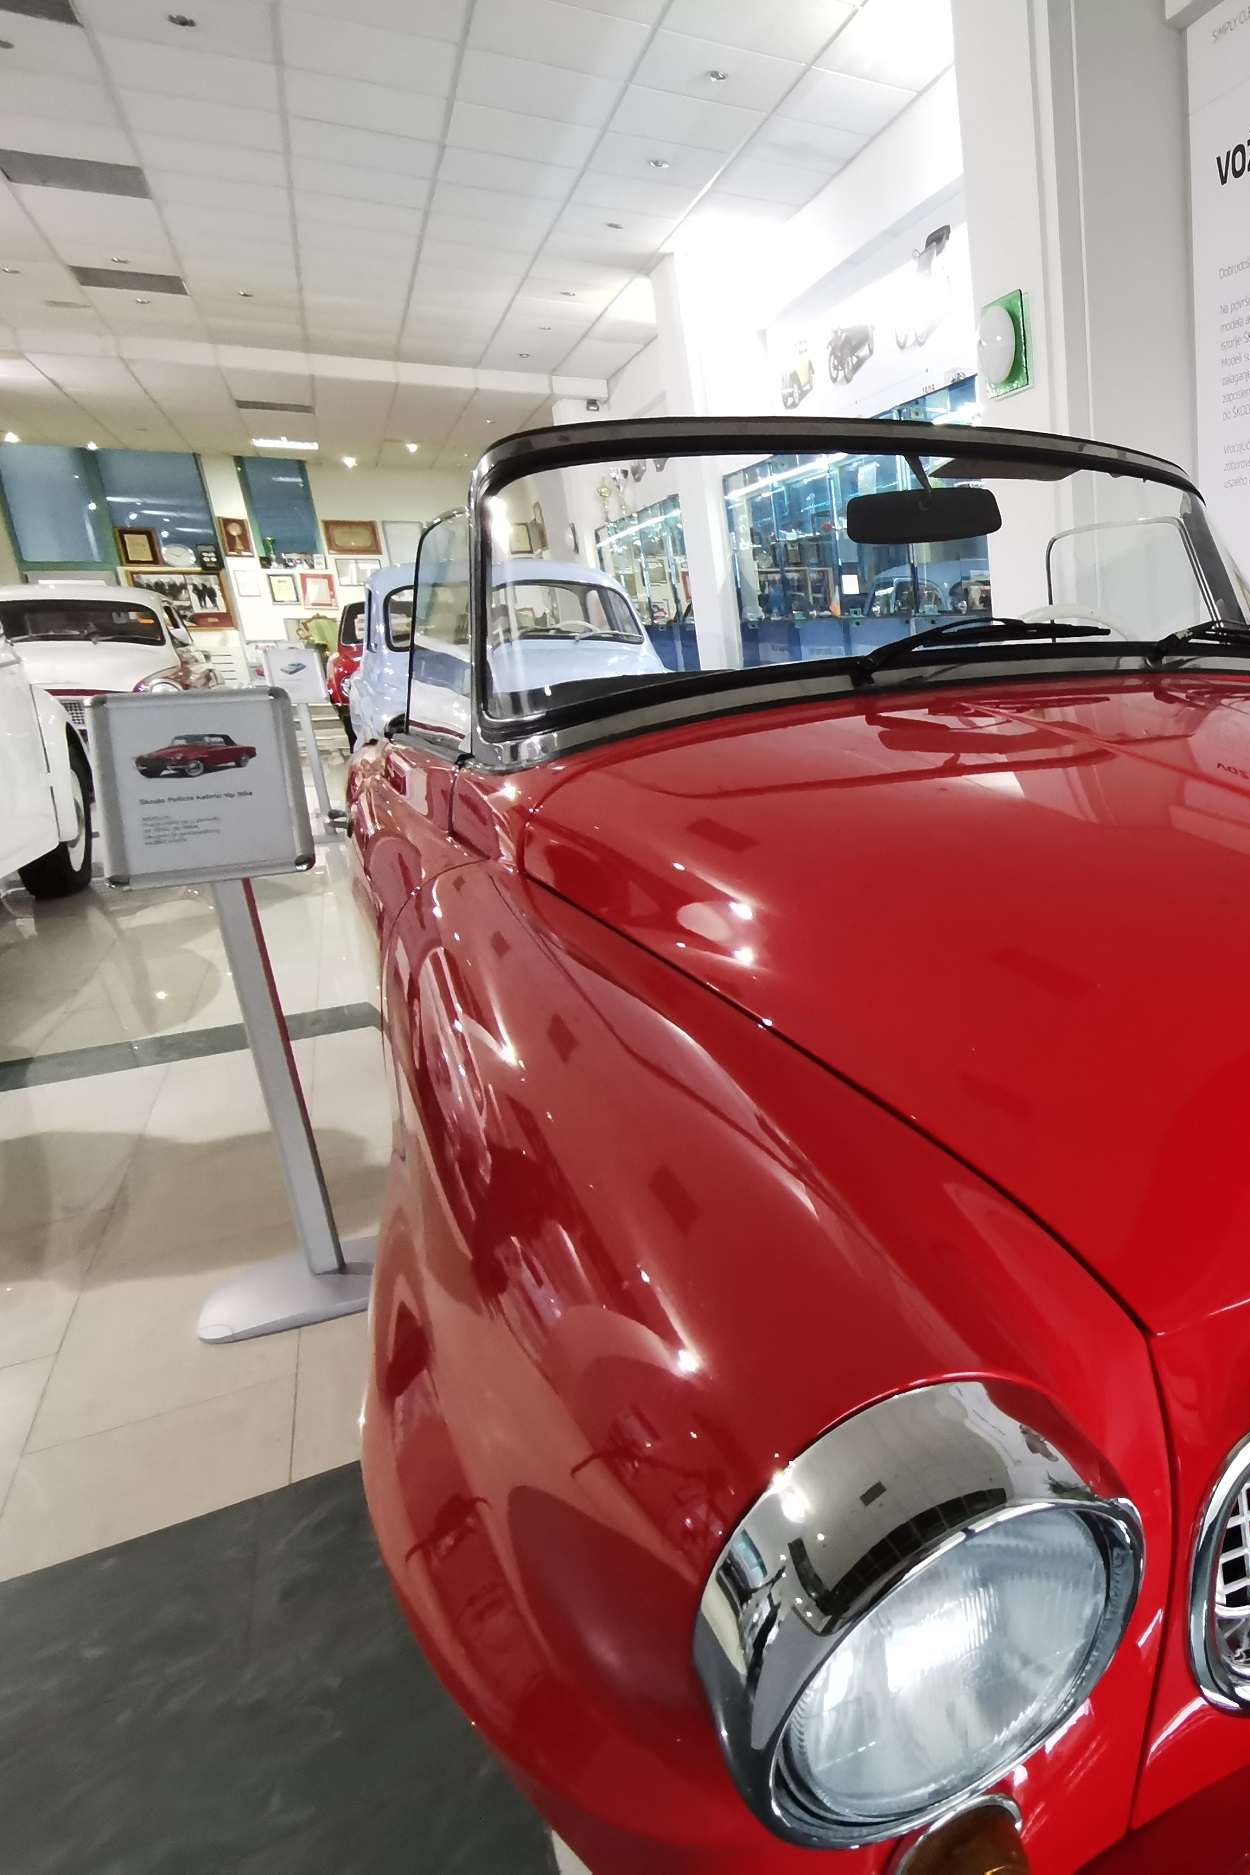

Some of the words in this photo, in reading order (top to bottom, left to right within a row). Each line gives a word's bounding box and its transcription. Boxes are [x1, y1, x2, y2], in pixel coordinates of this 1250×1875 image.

[1212, 17, 1238, 43] SIMPLY
[1220, 304, 1229, 314] Na
[1220, 318, 1244, 332] modela
[1220, 336, 1242, 351] istorije
[1221, 352, 1242, 367] Modeli
[1222, 411, 1231, 421] po
